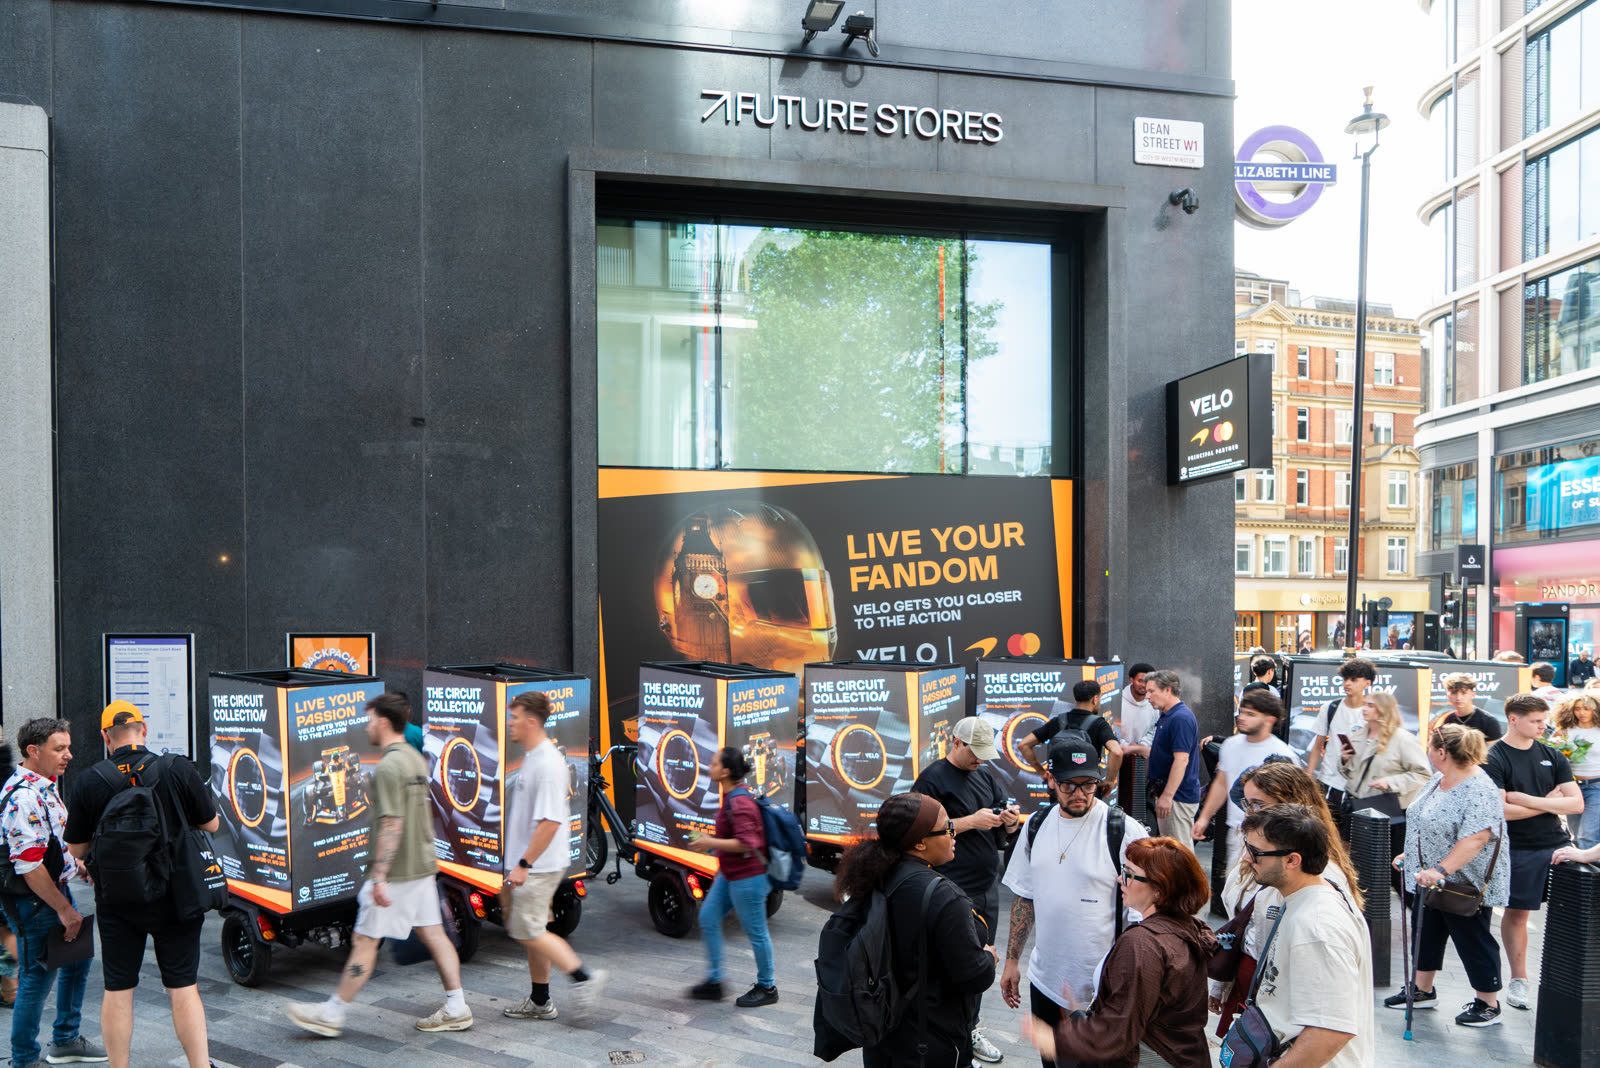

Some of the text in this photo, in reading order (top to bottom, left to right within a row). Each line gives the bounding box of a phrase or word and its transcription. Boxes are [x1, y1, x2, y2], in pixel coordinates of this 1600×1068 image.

[735, 91, 1004, 143] FUTURE STORES
[1142, 122, 1170, 135] DEAN
[1142, 136, 1198, 151] STREET W1
[1234, 166, 1331, 179] LIZABETH LINE
[1189, 388, 1233, 417] VELO
[1571, 500, 1585, 509] OF
[847, 522, 1026, 560] LIVE YOUR
[850, 555, 999, 592] FANDOM
[1542, 583, 1600, 599] PANDOR
[853, 590, 1022, 616] VELO GETS YOU CLOSER
[854, 609, 962, 630] TO THE ACTION
[302, 648, 360, 671] BACKPACKS
[811, 678, 886, 693] THE CIRCUIT
[922, 680, 938, 694] LIVE
[938, 674, 957, 689] YOUR
[983, 673, 1008, 685] THE
[1010, 671, 1061, 685] CIRCUIT
[1300, 675, 1329, 687] THE
[426, 686, 482, 701] THE CIRCUIT
[643, 682, 702, 696] THE CIRCUIT
[733, 684, 785, 702] LIVE YOUR
[922, 687, 952, 705] PASSION
[984, 682, 1066, 695] COLLECTION
[211, 694, 264, 708] THE CIRCUIT
[294, 690, 366, 714] LIVE YOUR
[643, 694, 705, 709] COLLECTION
[812, 690, 890, 705] COLLECTION
[427, 699, 485, 714] COLLECTION
[733, 697, 777, 715] PASSION
[213, 708, 268, 722] COLLECTION
[296, 705, 356, 728] PASSION
[558, 710, 580, 720] CLOSER
[298, 726, 316, 735] VELO
[316, 723, 334, 732] GETS
[334, 719, 348, 728] YOU
[733, 720, 741, 728] TO
[309, 731, 322, 739] THE
[323, 726, 347, 737] ACTION
[313, 839, 326, 847] FIND
[341, 829, 360, 839] FUTURE
[326, 844, 349, 855] OXFORD
[484, 853, 499, 864] VELO
